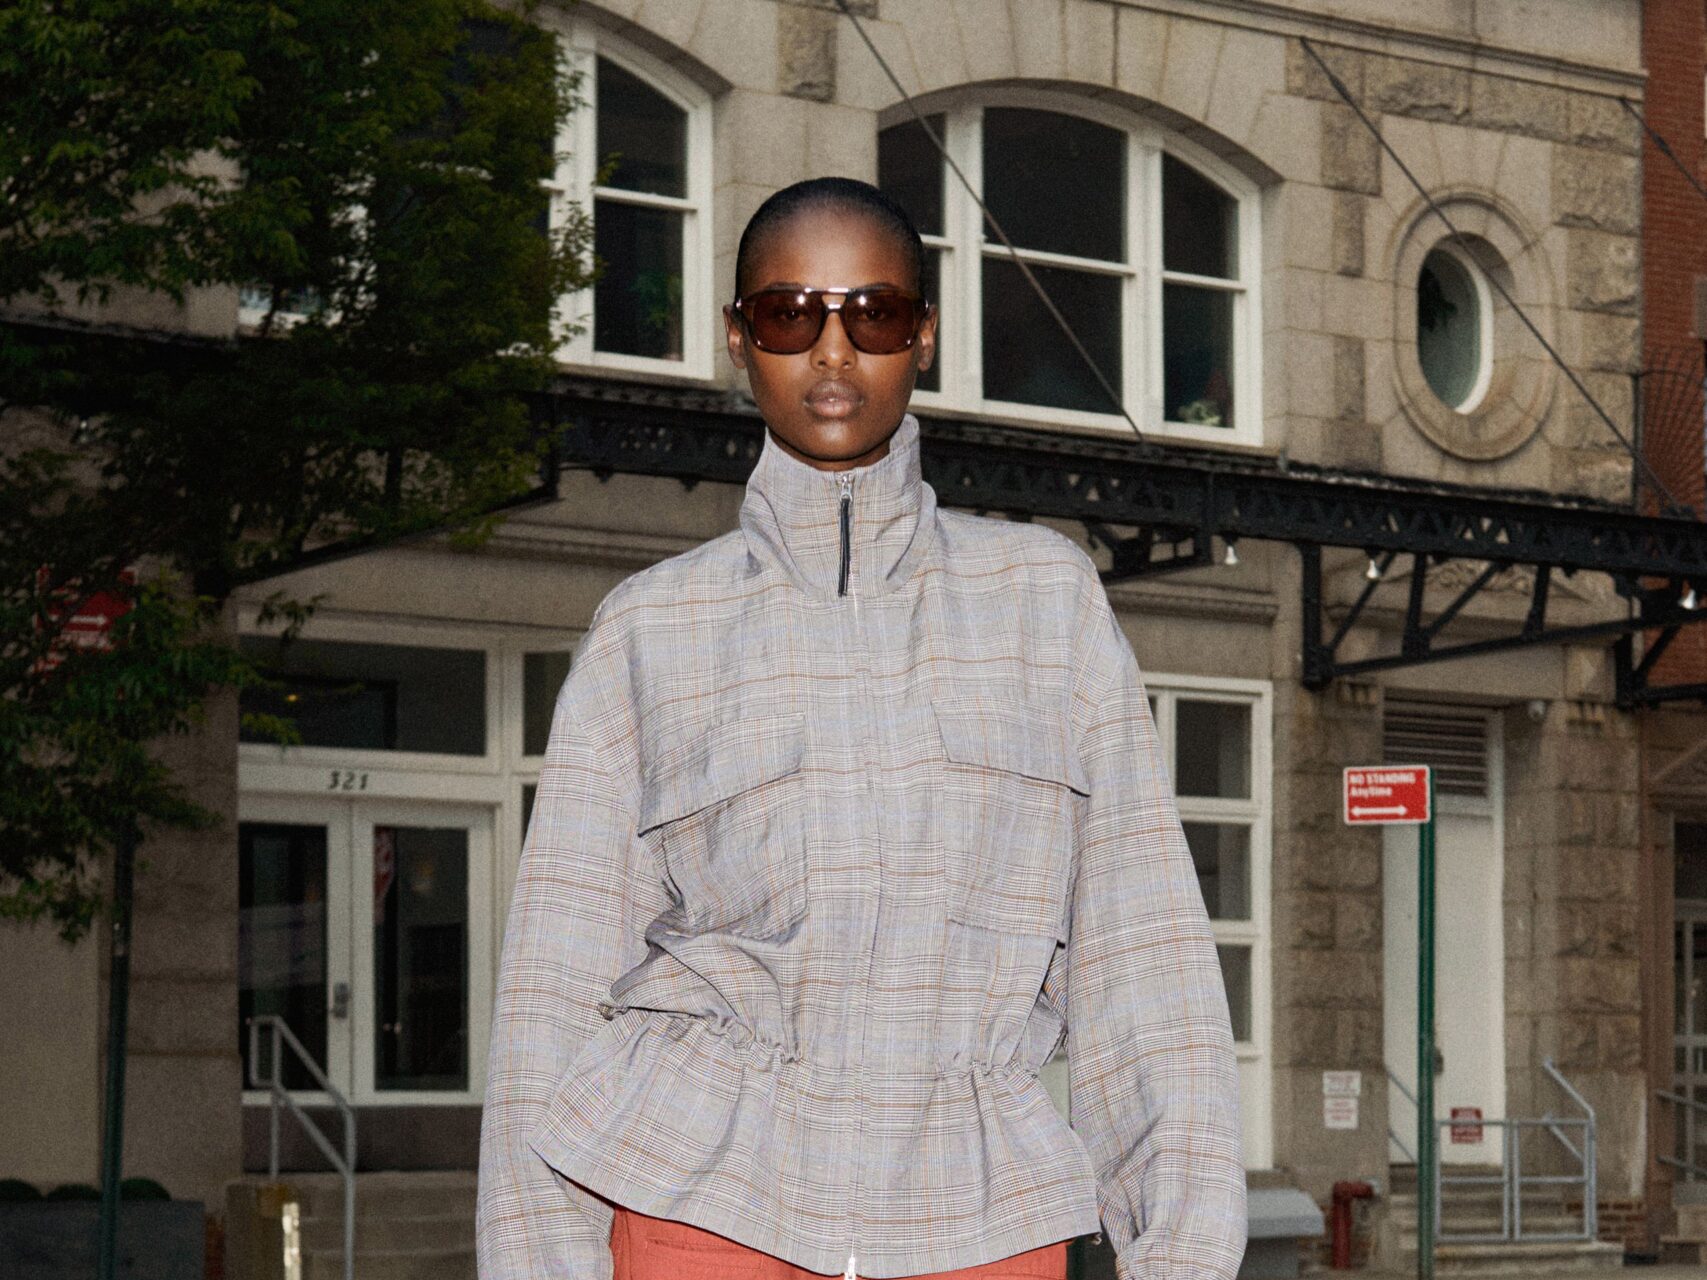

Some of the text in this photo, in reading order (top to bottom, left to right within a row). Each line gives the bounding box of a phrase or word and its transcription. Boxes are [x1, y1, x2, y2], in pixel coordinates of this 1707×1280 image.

[330, 770, 369, 790] 321
[1350, 772, 1416, 785] NO STANDING
[1350, 786, 1393, 799] Anytime
